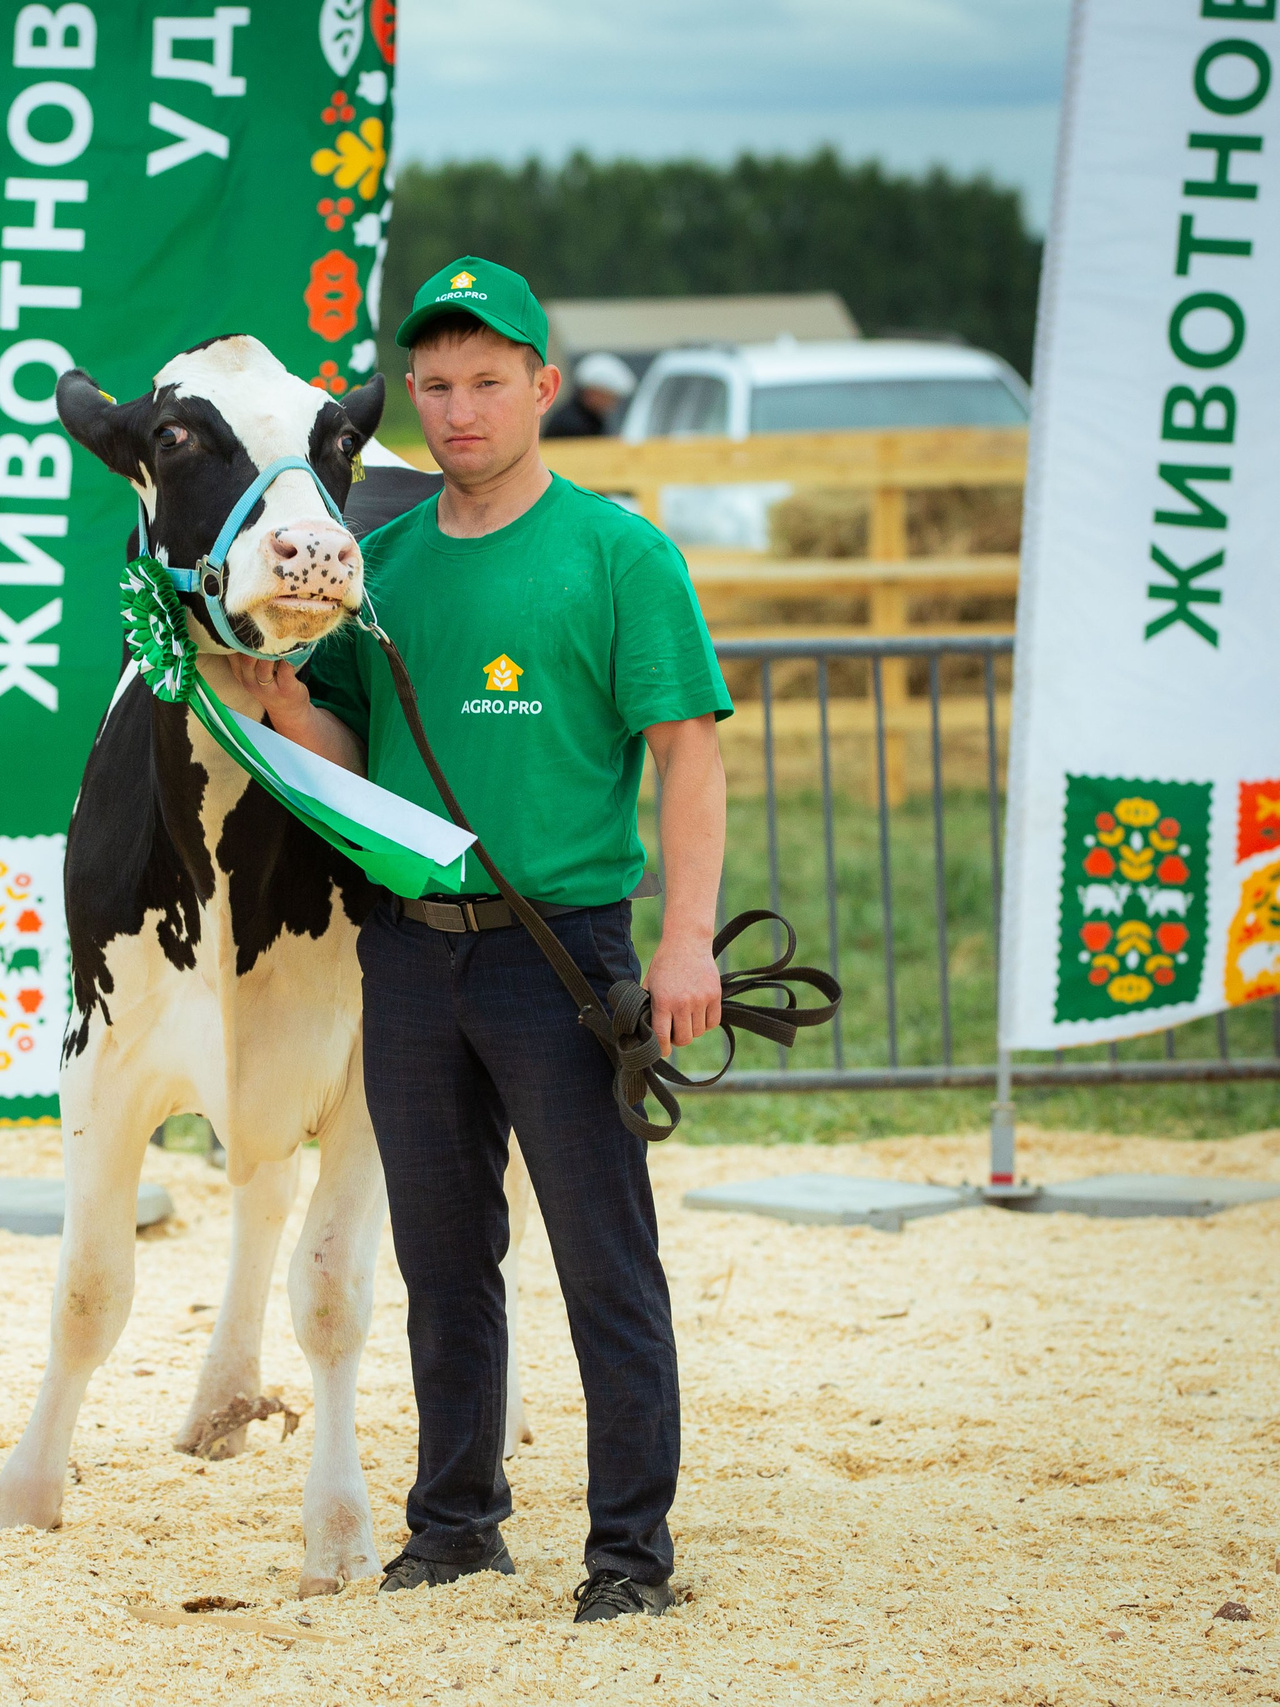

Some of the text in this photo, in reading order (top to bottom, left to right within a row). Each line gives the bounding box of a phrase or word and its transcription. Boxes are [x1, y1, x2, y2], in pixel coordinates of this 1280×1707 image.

[146, 6, 250, 177] УД
[435, 291, 487, 302] AGRO.PRO
[461, 699, 542, 715] AGRO.PRO
